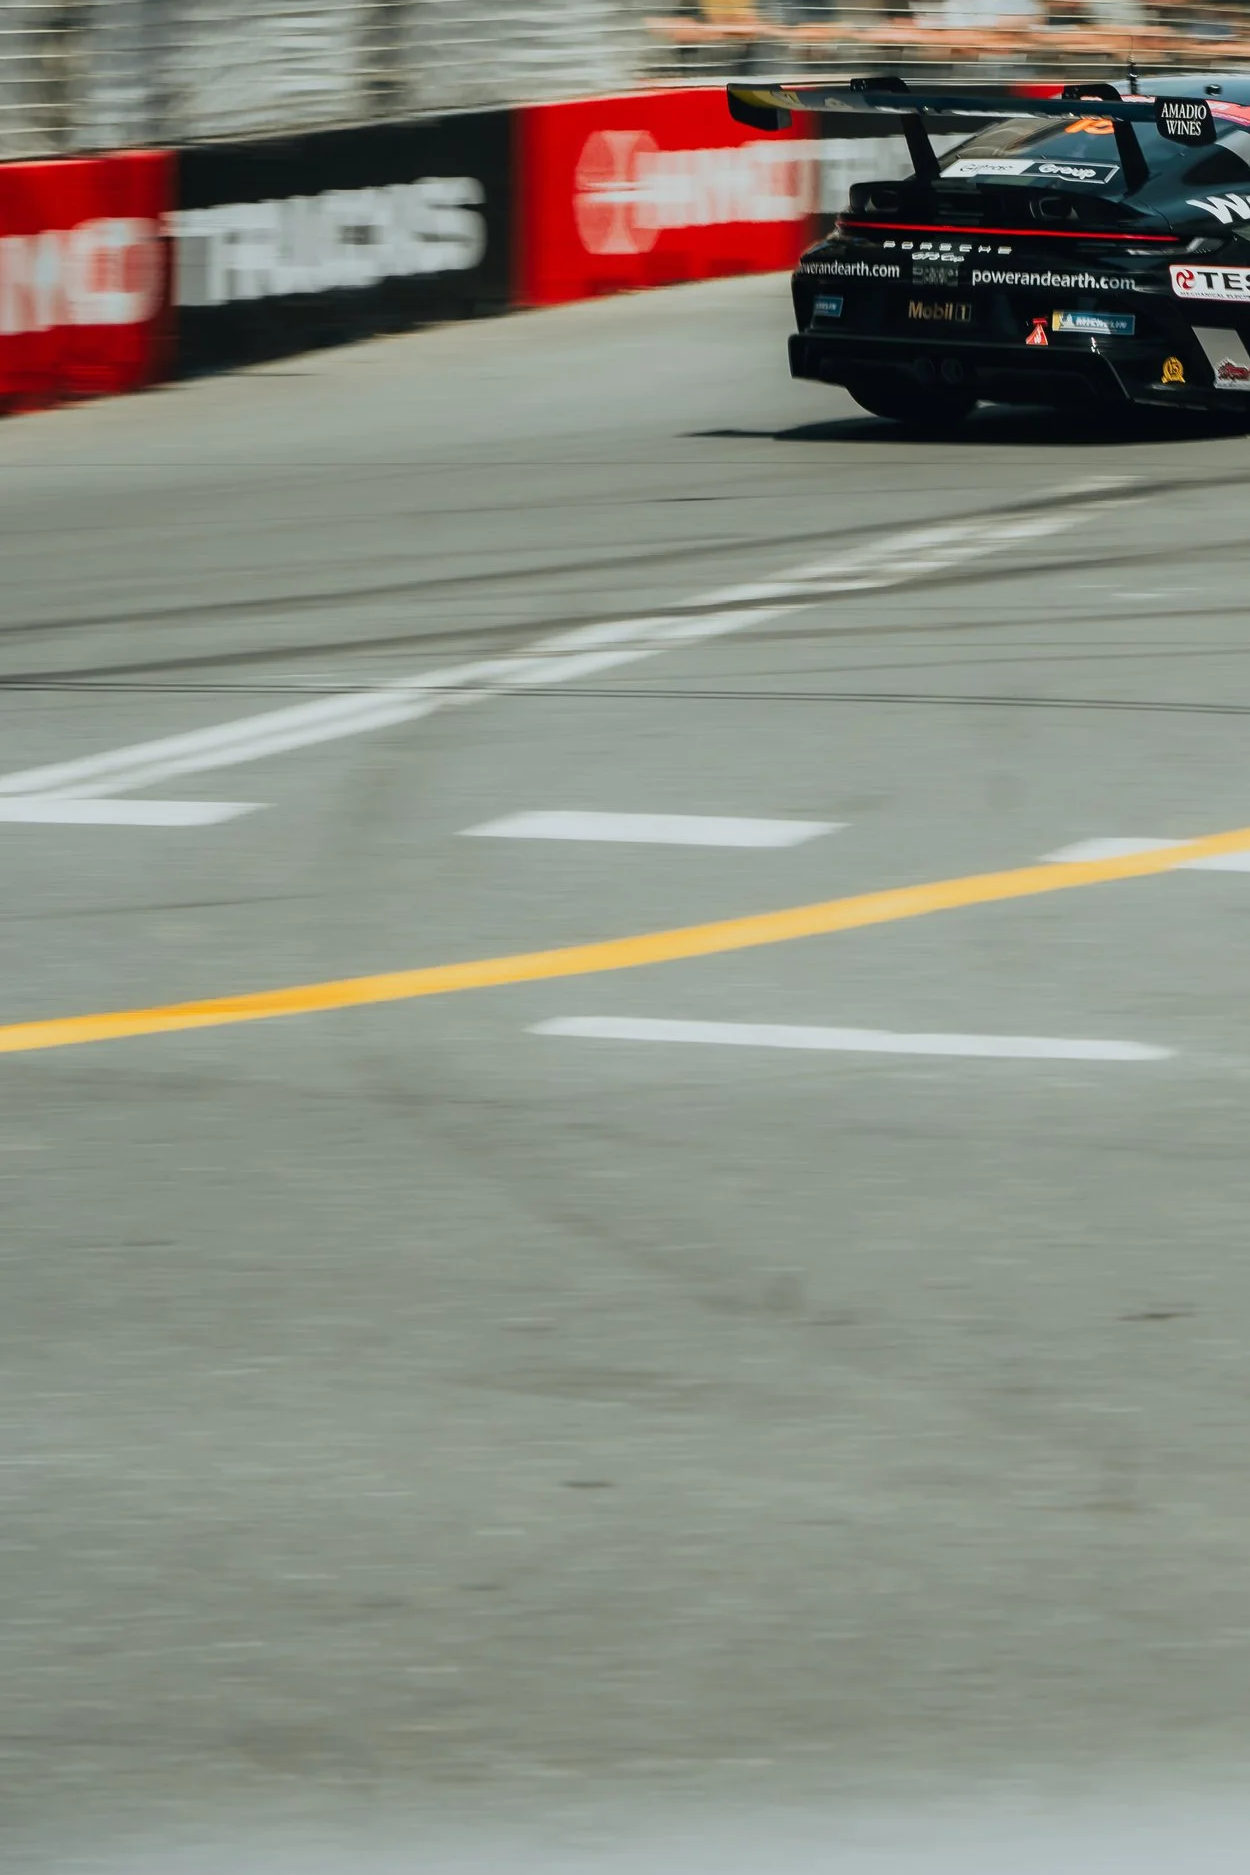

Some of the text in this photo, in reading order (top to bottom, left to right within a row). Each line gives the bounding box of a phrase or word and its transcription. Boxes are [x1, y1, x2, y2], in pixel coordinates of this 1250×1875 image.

[1161, 103, 1207, 120] AMADIO
[1166, 119, 1202, 136] WINES
[160, 176, 488, 307] TRUCKS
[972, 268, 1136, 291] powerandearth.com
[908, 301, 953, 321] Mobil
